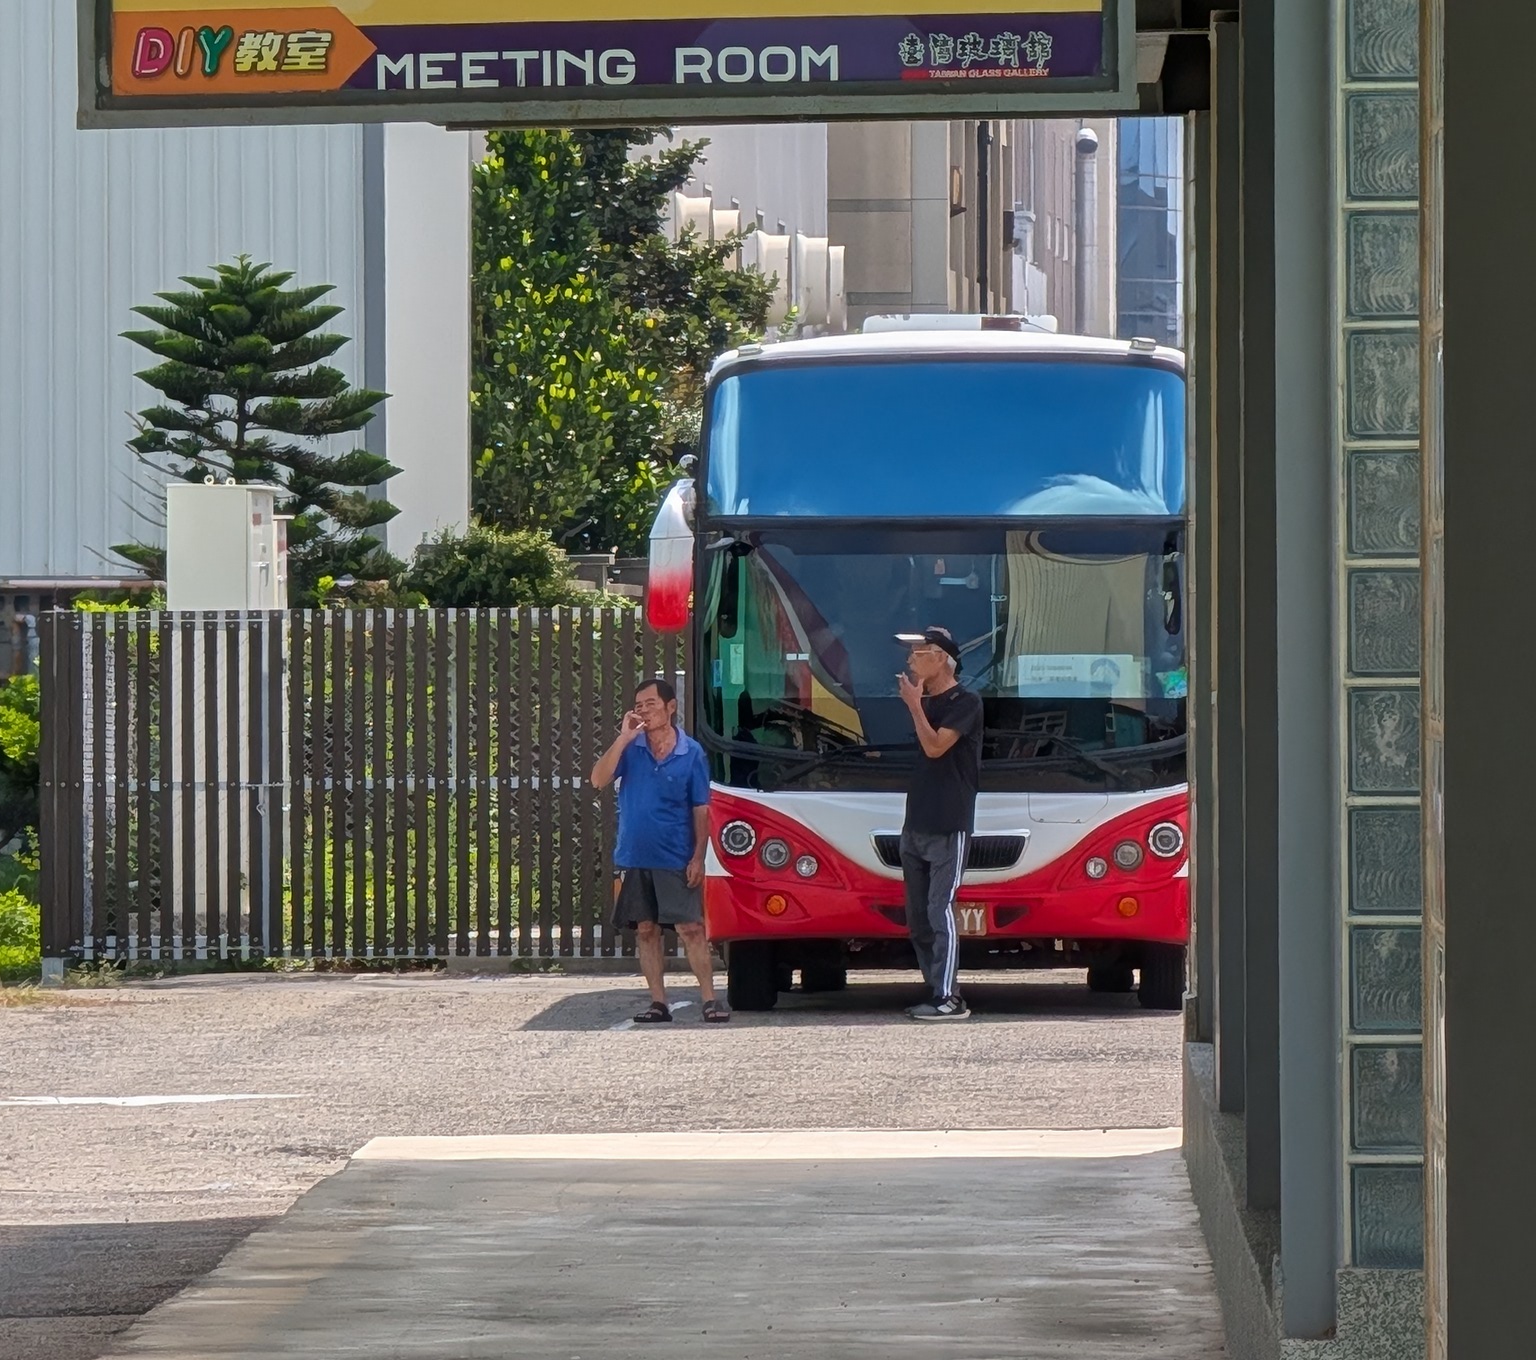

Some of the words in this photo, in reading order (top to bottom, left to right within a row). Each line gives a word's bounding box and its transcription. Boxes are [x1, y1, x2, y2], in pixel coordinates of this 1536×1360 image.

[377, 49, 636, 90] MEETING
[675, 45, 839, 84] ROOM
[969, 69, 1002, 78] GLASS
[1005, 68, 1050, 77] GALLERY
